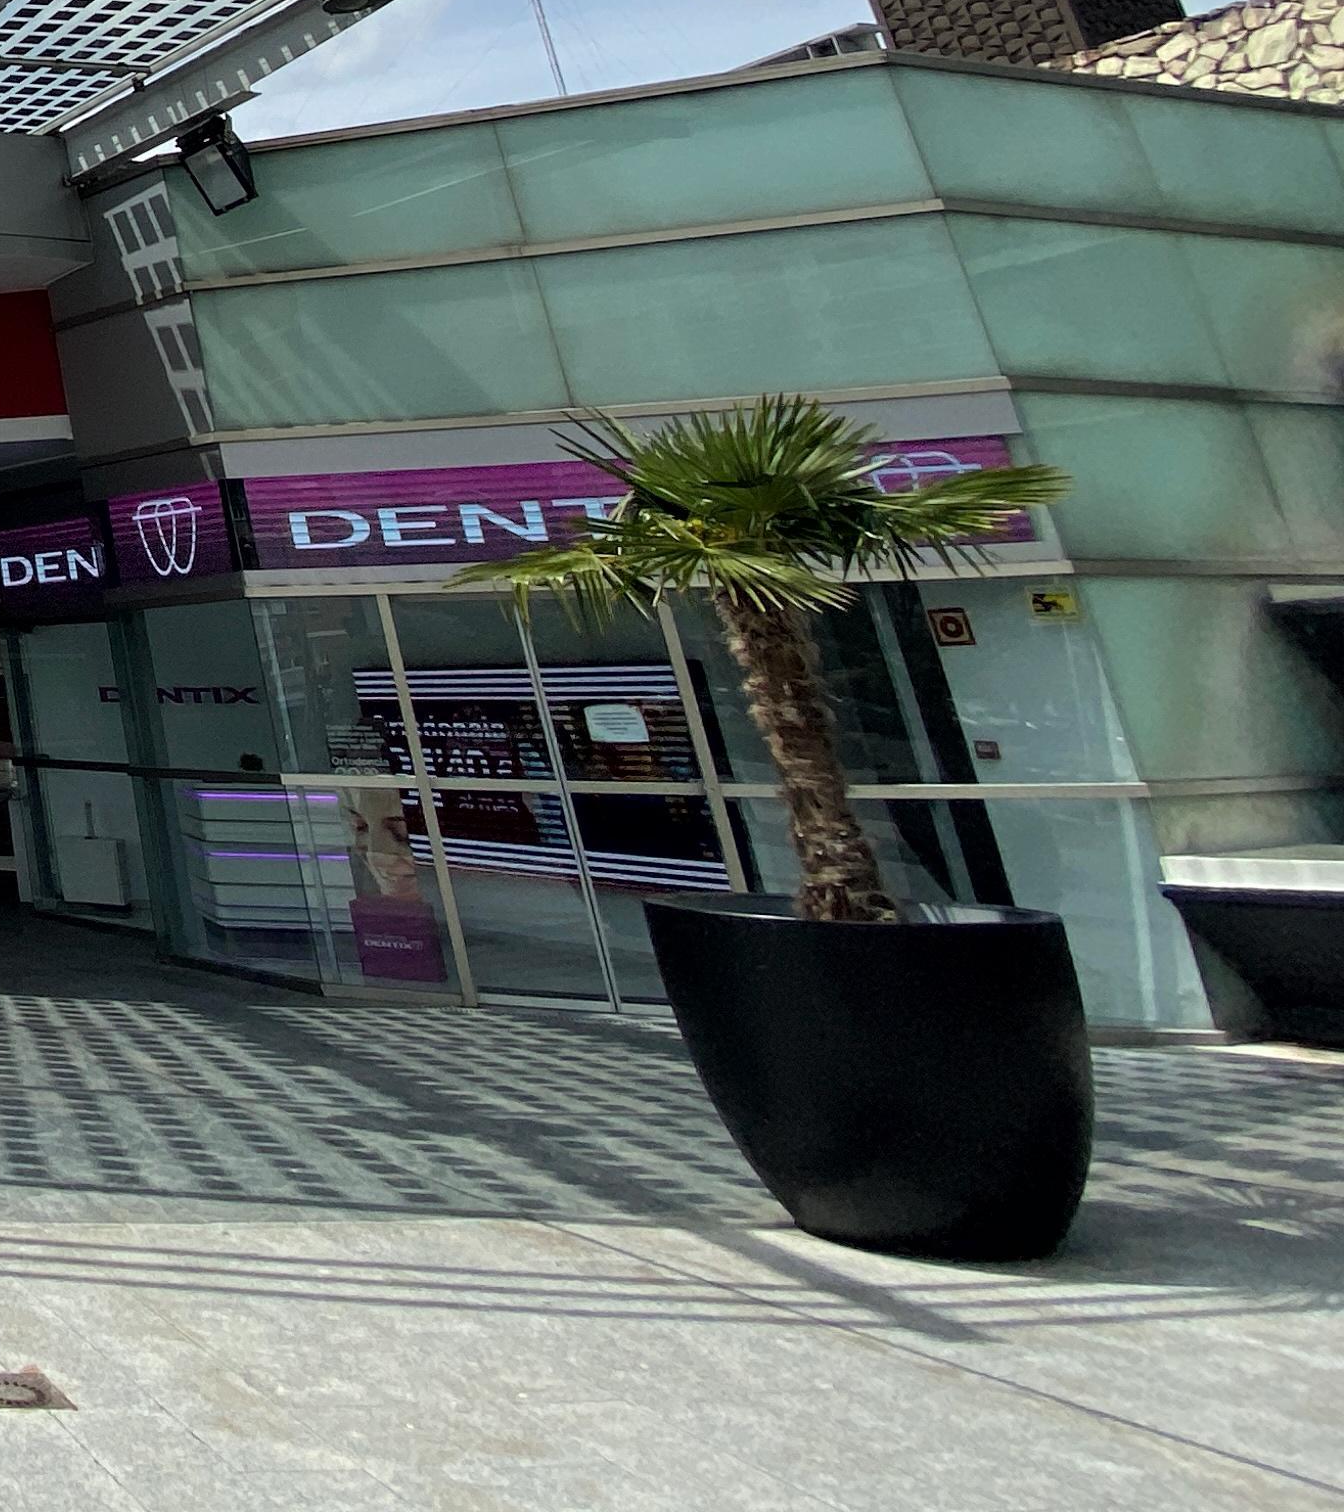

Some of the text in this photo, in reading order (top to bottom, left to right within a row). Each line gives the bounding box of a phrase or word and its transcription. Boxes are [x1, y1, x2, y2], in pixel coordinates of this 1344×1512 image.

[289, 495, 626, 550] DENT
[0, 546, 100, 587] DEN
[98, 686, 260, 705] DNTIX
